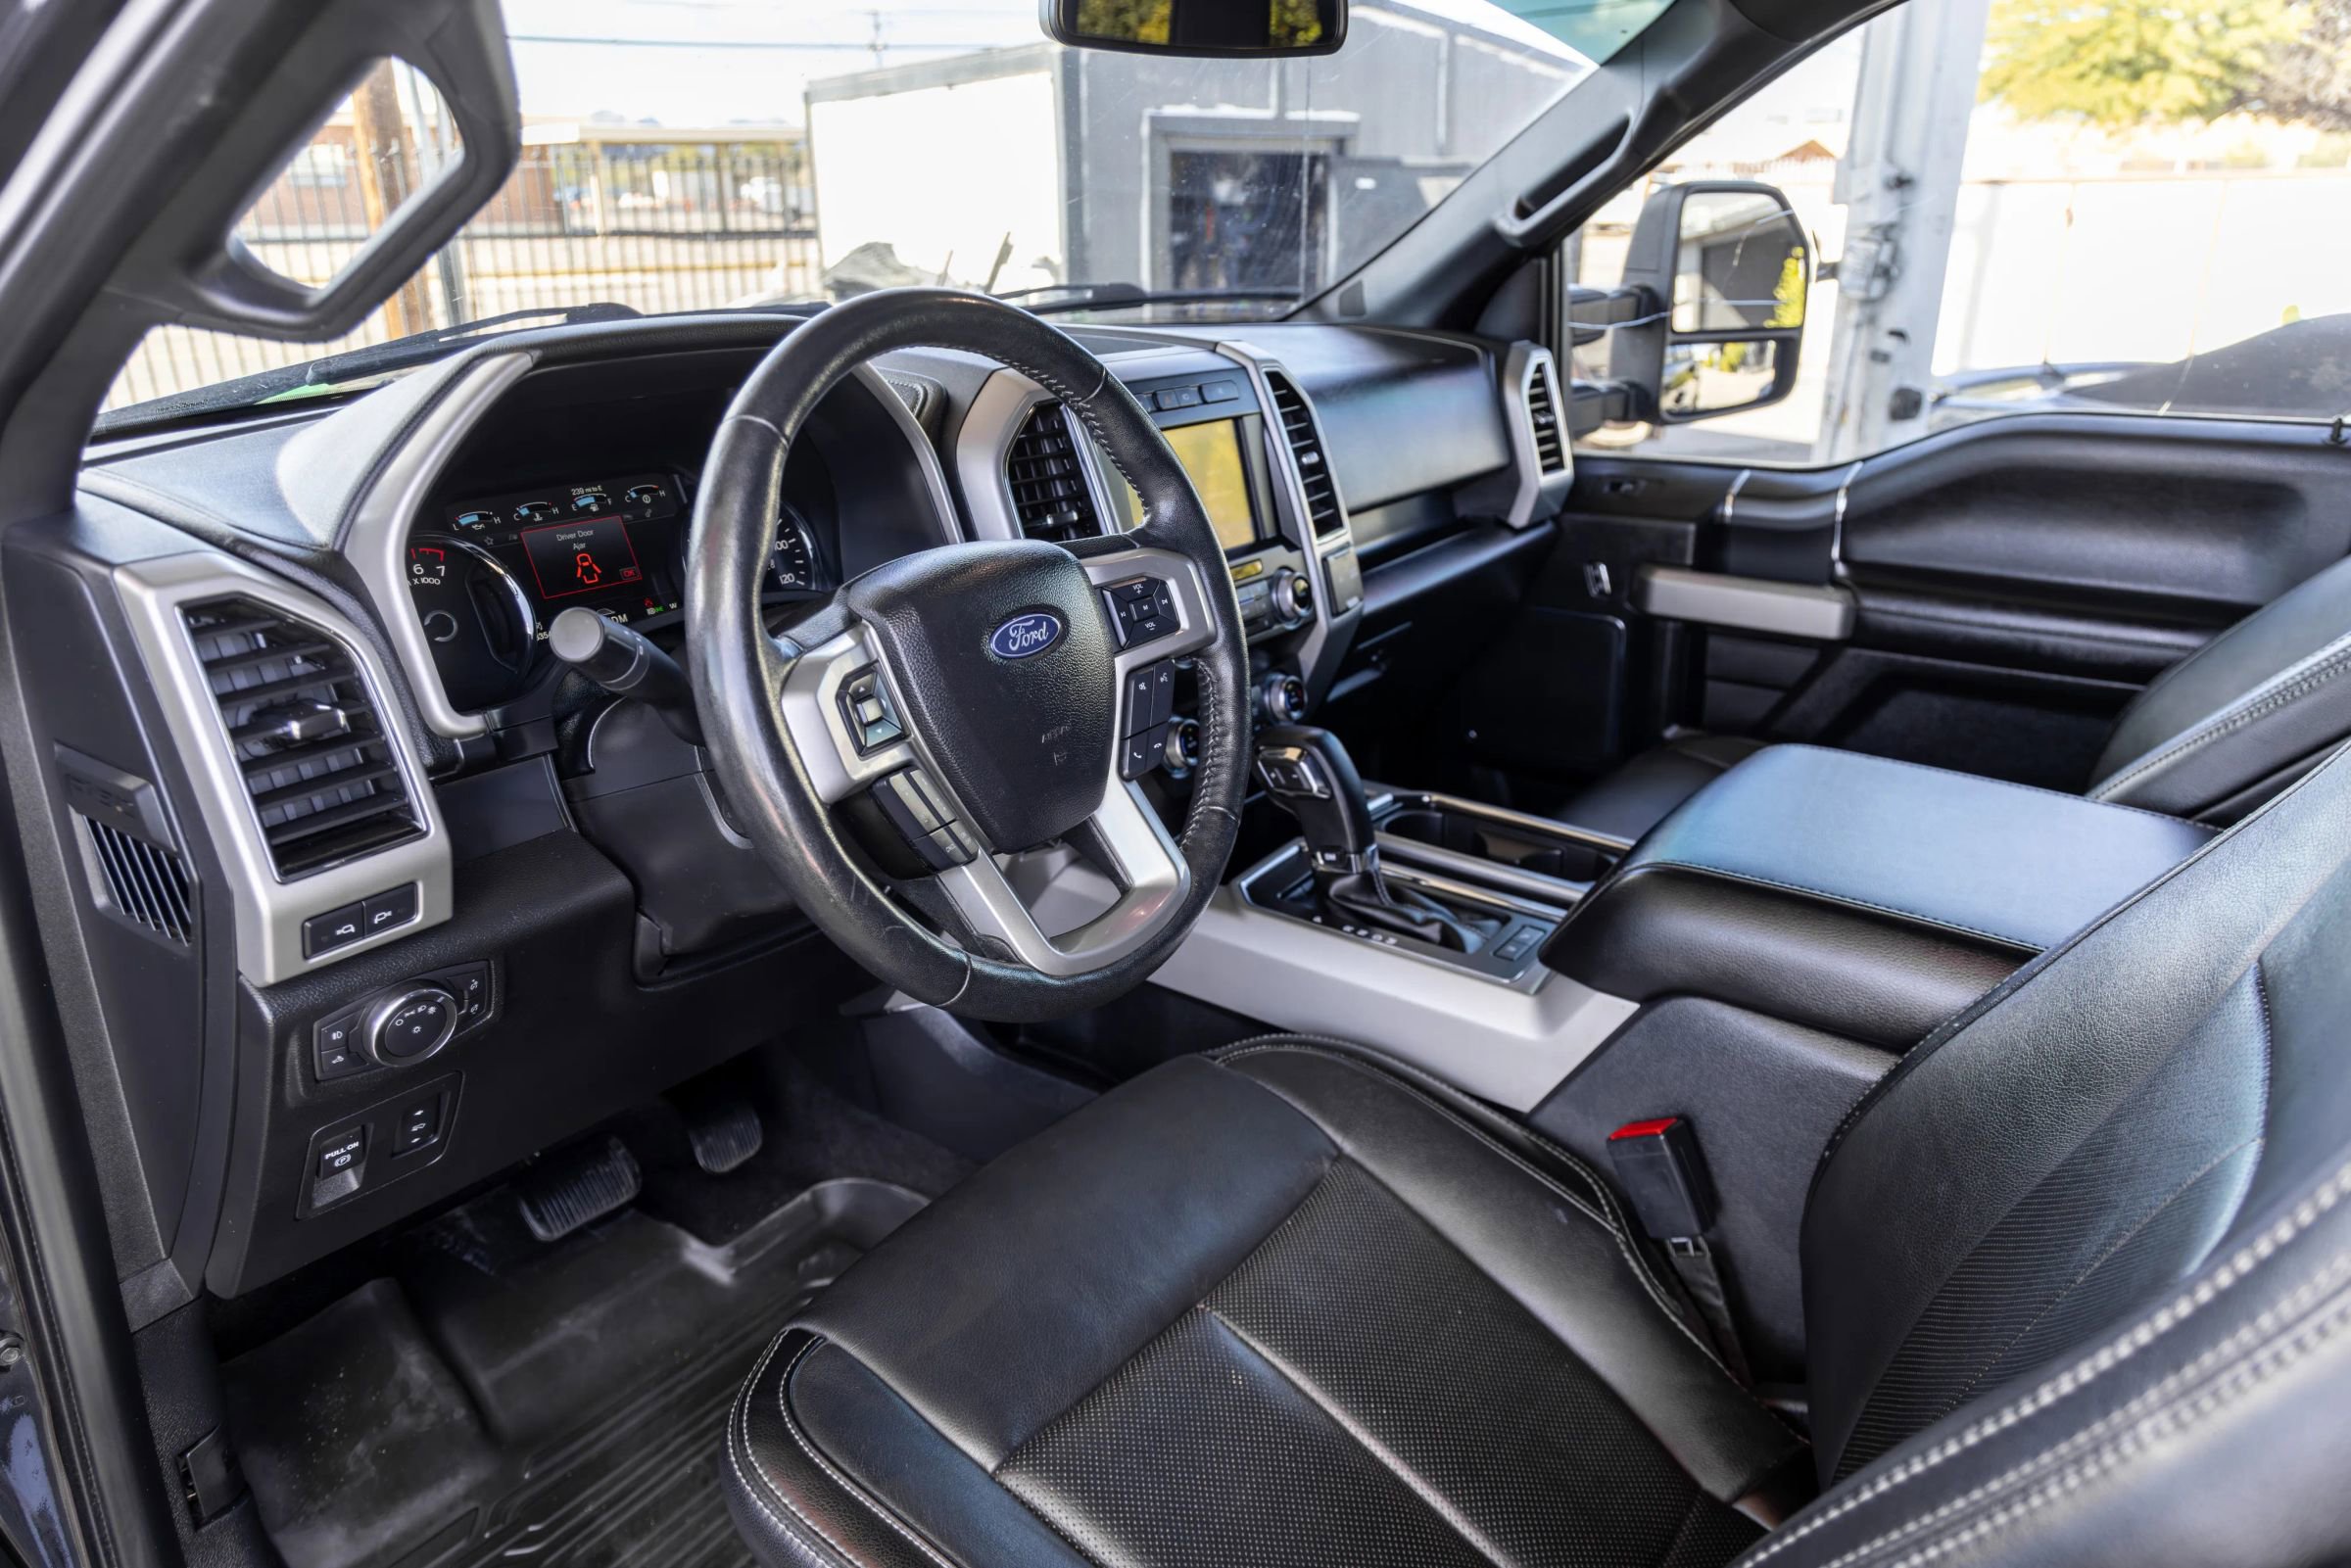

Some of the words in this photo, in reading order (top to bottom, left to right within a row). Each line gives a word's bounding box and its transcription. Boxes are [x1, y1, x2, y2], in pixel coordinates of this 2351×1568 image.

[570, 487, 585, 496] 239
[552, 506, 559, 515] H
[493, 516, 501, 525] H
[556, 533, 576, 542] Driver
[577, 529, 594, 538] Door
[412, 563, 424, 575] 6
[435, 565, 446, 577] 7
[421, 577, 441, 586] 1000
[779, 573, 795, 586] 120
[1132, 583, 1143, 592] VOL
[1008, 619, 1049, 651] Ford
[325, 1148, 347, 1160] PULL
[347, 1141, 360, 1151] ON
